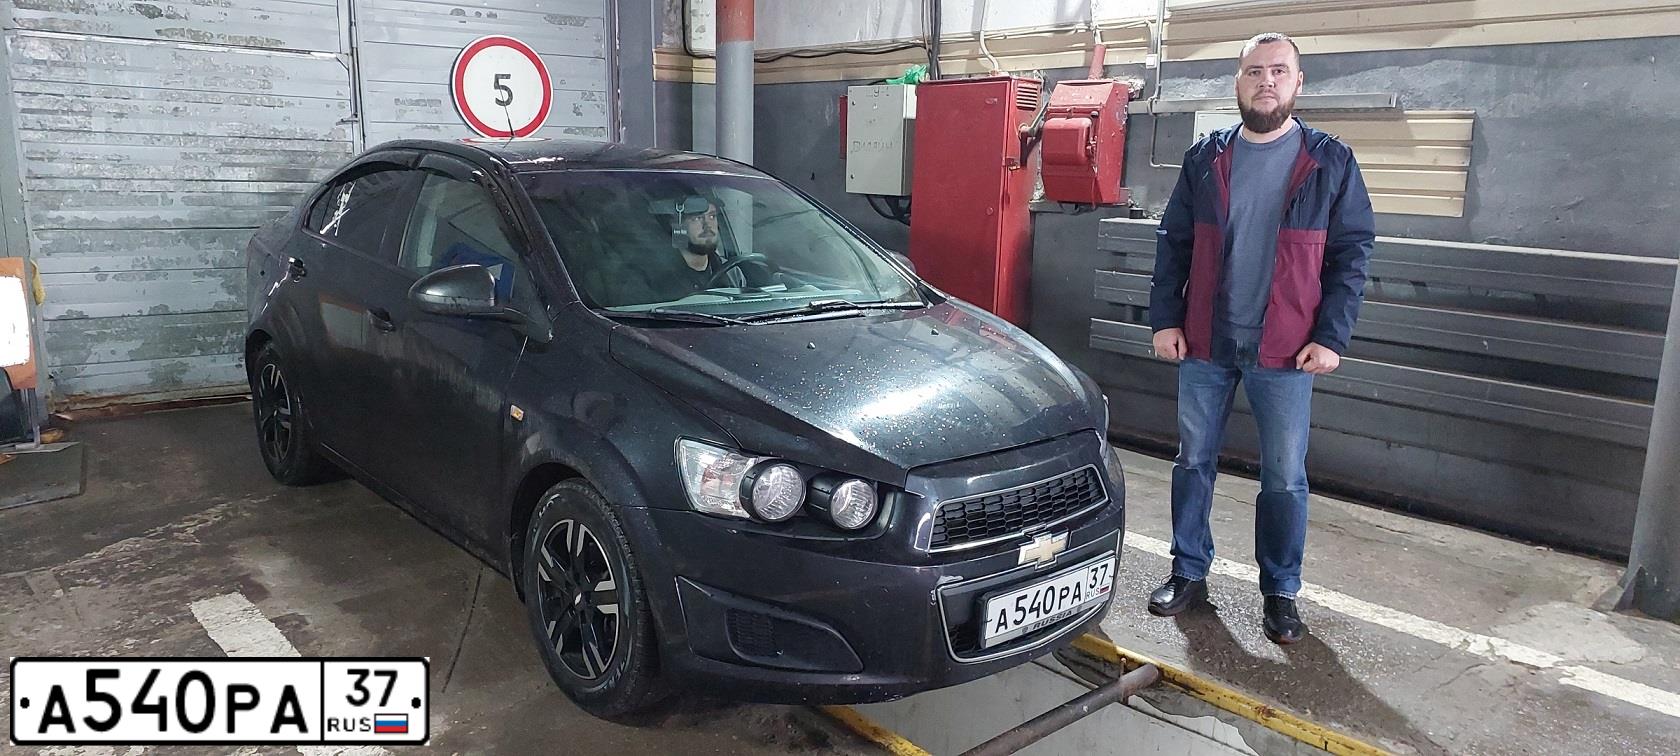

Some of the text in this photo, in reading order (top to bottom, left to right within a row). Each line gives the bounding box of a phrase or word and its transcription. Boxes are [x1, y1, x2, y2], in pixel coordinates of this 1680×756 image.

[494, 74, 513, 106] 5
[1089, 563, 1108, 589] 37
[1086, 588, 1100, 599] RUS
[1033, 610, 1072, 630] RUSSIA
